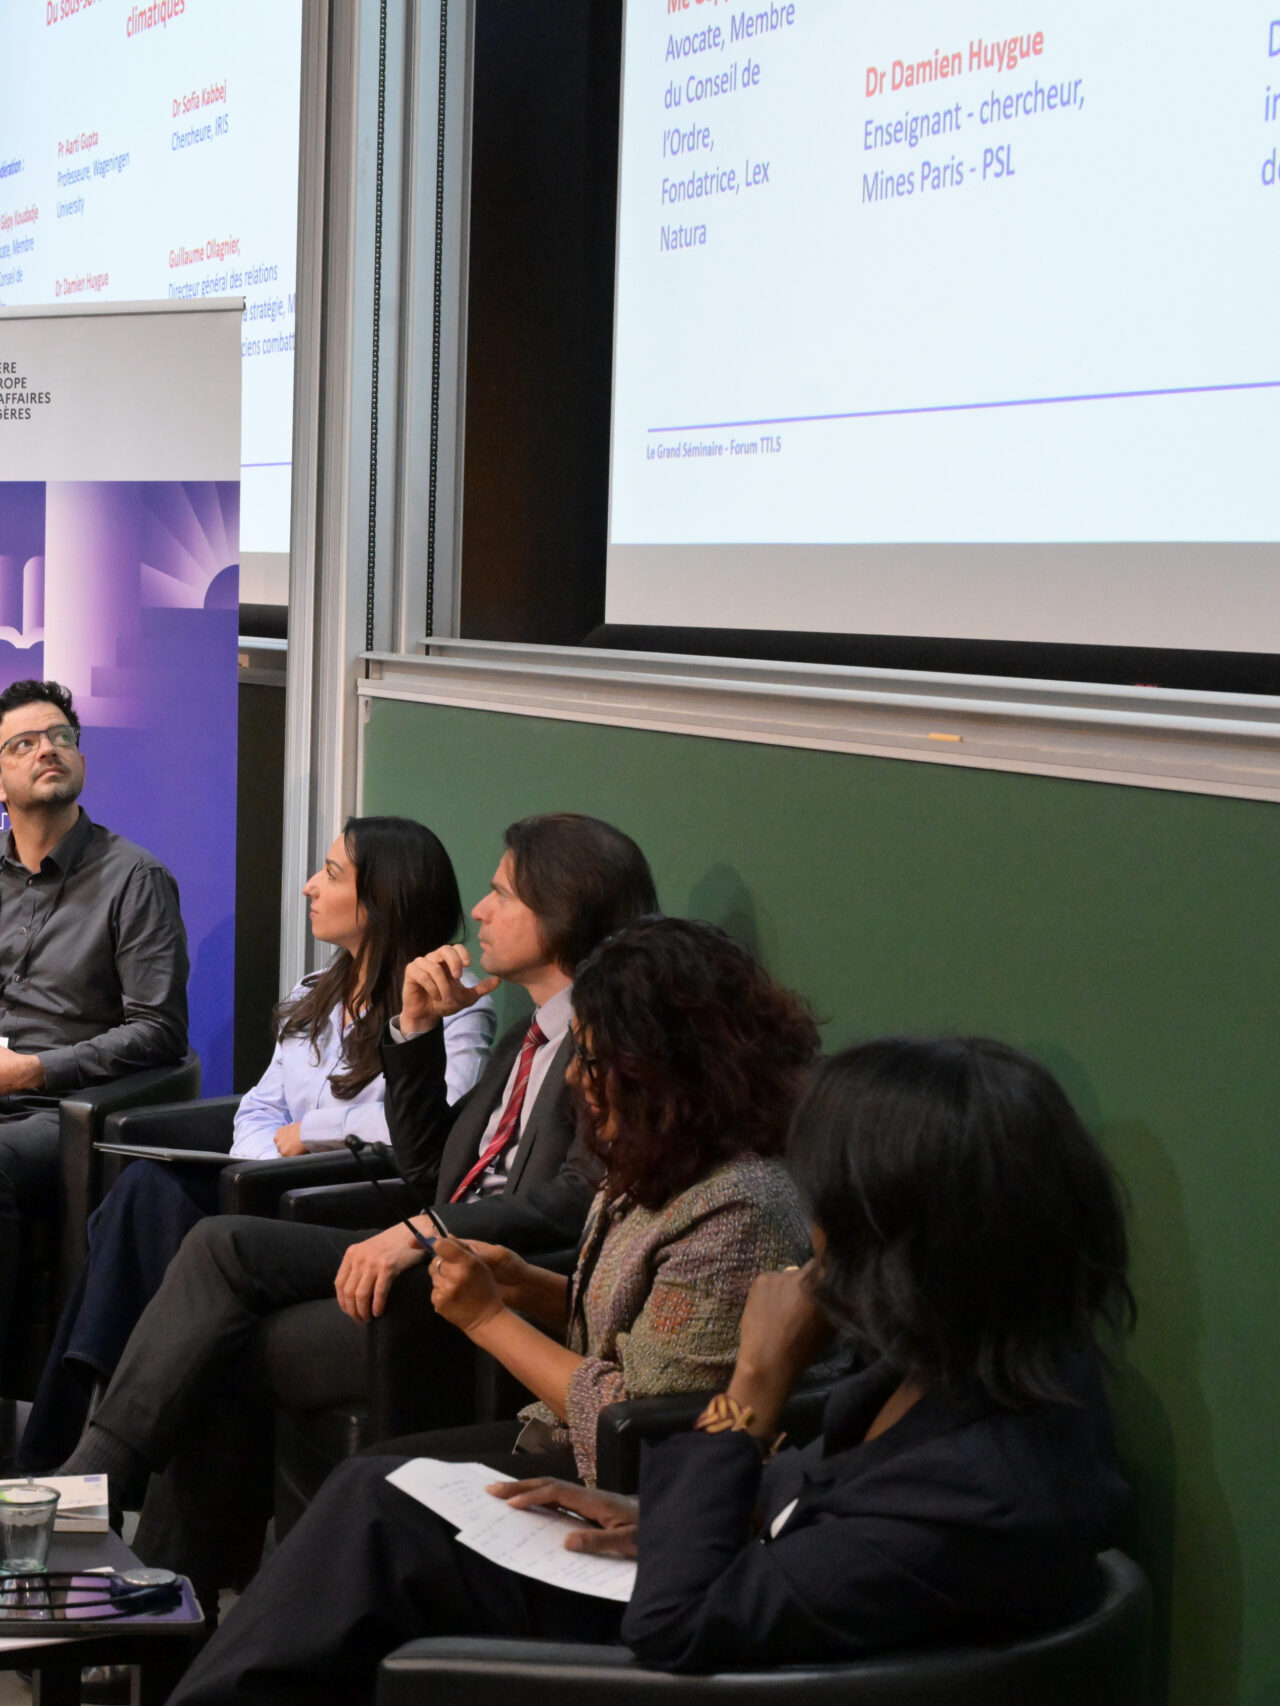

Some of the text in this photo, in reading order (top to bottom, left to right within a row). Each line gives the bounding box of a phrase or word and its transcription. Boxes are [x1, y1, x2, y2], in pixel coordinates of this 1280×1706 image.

[126, 0, 185, 38] climatiques
[665, 2, 795, 62] Avocate, Membre
[865, 30, 1044, 98] Dr Damien Huygue
[664, 57, 760, 109] du Conseil de
[172, 98, 181, 118] Dr
[182, 90, 200, 114] Sofia
[864, 101, 962, 150] Enseignant
[979, 78, 1085, 125] chercheur,
[80, 130, 98, 152] Gupta
[215, 112, 229, 137] IRIS
[663, 122, 714, 158] l'Ordre,
[661, 159, 770, 205] Fondatrice, Lex
[862, 169, 915, 203] Mines
[920, 154, 964, 192] Paris
[982, 143, 1015, 180] PSL
[660, 224, 707, 252] Natura
[168, 246, 205, 268] Guillaume
[63, 274, 85, 295] Damien
[168, 262, 278, 299] Directeur général des relations
[646, 445, 655, 460] Le
[657, 442, 681, 459] Grand
[682, 440, 723, 458] Séminaire
[730, 438, 757, 455] Forum
